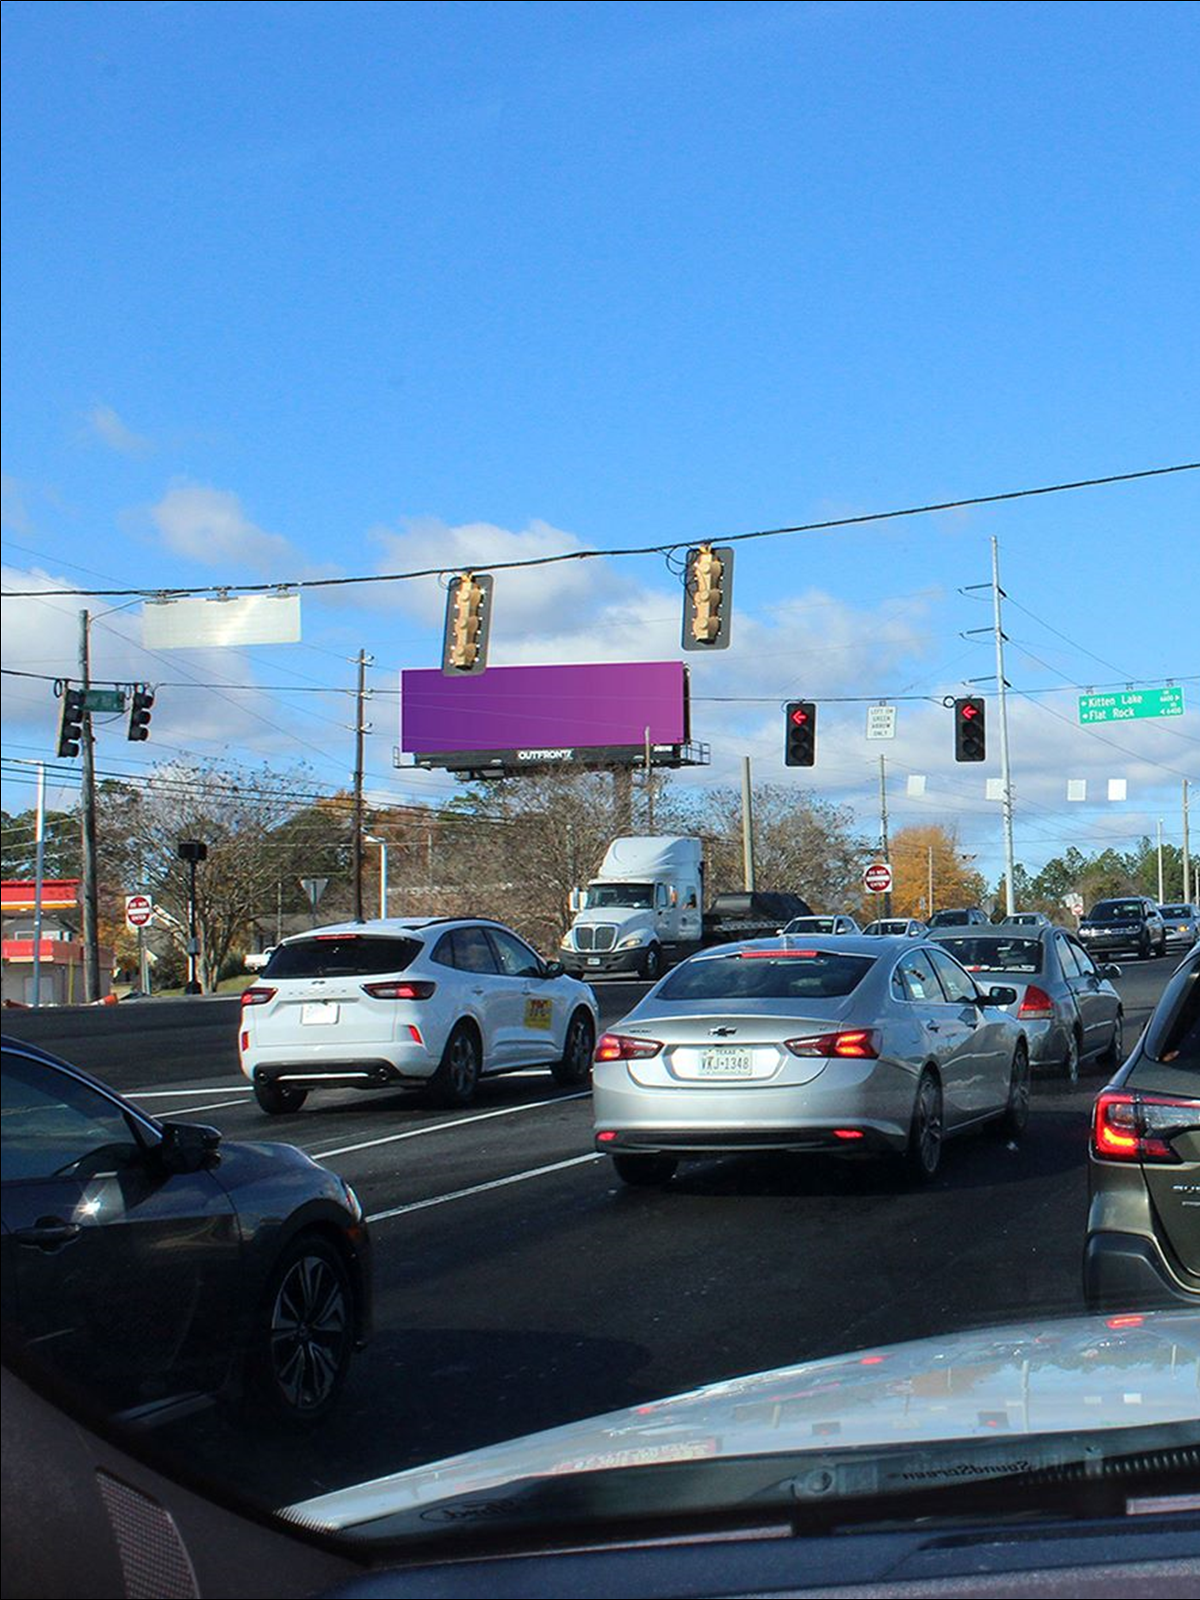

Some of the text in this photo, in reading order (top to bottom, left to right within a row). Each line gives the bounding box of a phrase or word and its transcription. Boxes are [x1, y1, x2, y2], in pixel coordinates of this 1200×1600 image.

[1088, 695, 1143, 707] Kitten Lake
[1089, 708, 1135, 720] Flat Rock
